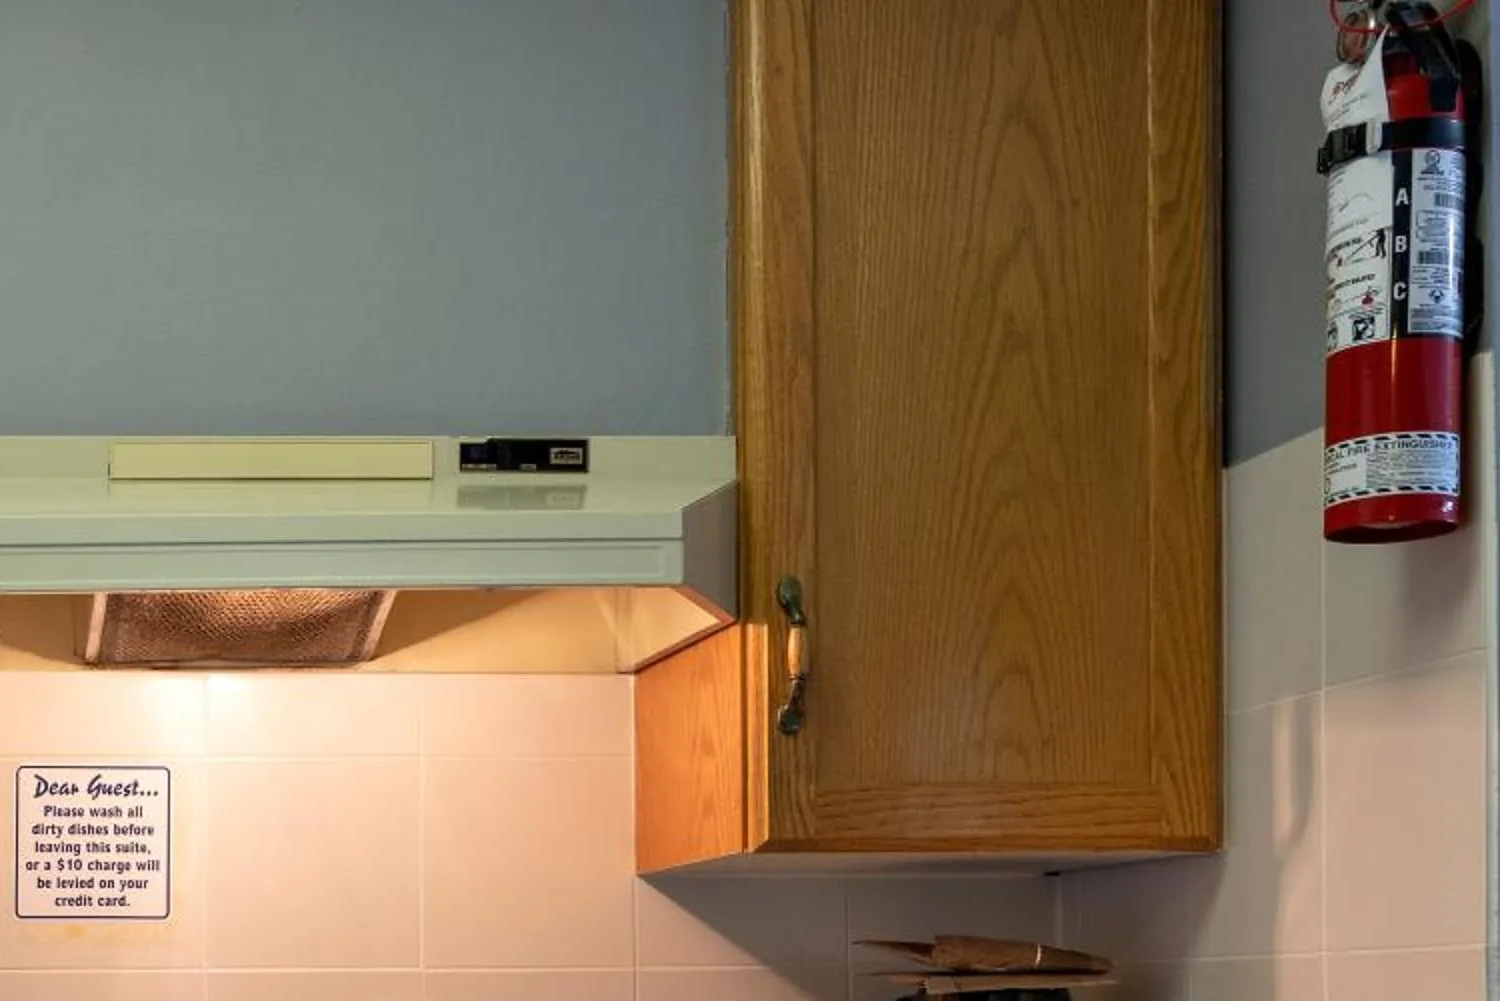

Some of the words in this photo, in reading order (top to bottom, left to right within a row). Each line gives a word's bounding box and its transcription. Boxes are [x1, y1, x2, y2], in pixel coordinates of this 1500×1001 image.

[1396, 187, 1409, 206] A
[1395, 235, 1407, 252] B
[1393, 281, 1407, 301] C
[33, 773, 79, 799] Dear
[86, 773, 159, 800] Guest...
[43, 805, 85, 817] Please
[89, 805, 123, 817] wash
[127, 805, 144, 817] all
[31, 823, 64, 838] dirty
[67, 823, 109, 836] dishes
[113, 823, 155, 836] before
[35, 841, 81, 856] leaving
[86, 841, 111, 853] this
[115, 841, 151, 855] suite,
[25, 861, 40, 871] or
[44, 861, 51, 871] a
[57, 858, 83, 872] $10
[87, 859, 132, 874] charge
[135, 859, 160, 871] will
[37, 877, 52, 889] be
[56, 877, 95, 889] levied
[99, 879, 115, 889] on
[120, 879, 149, 892] your
[55, 894, 93, 907] credit
[97, 894, 131, 907] card.
